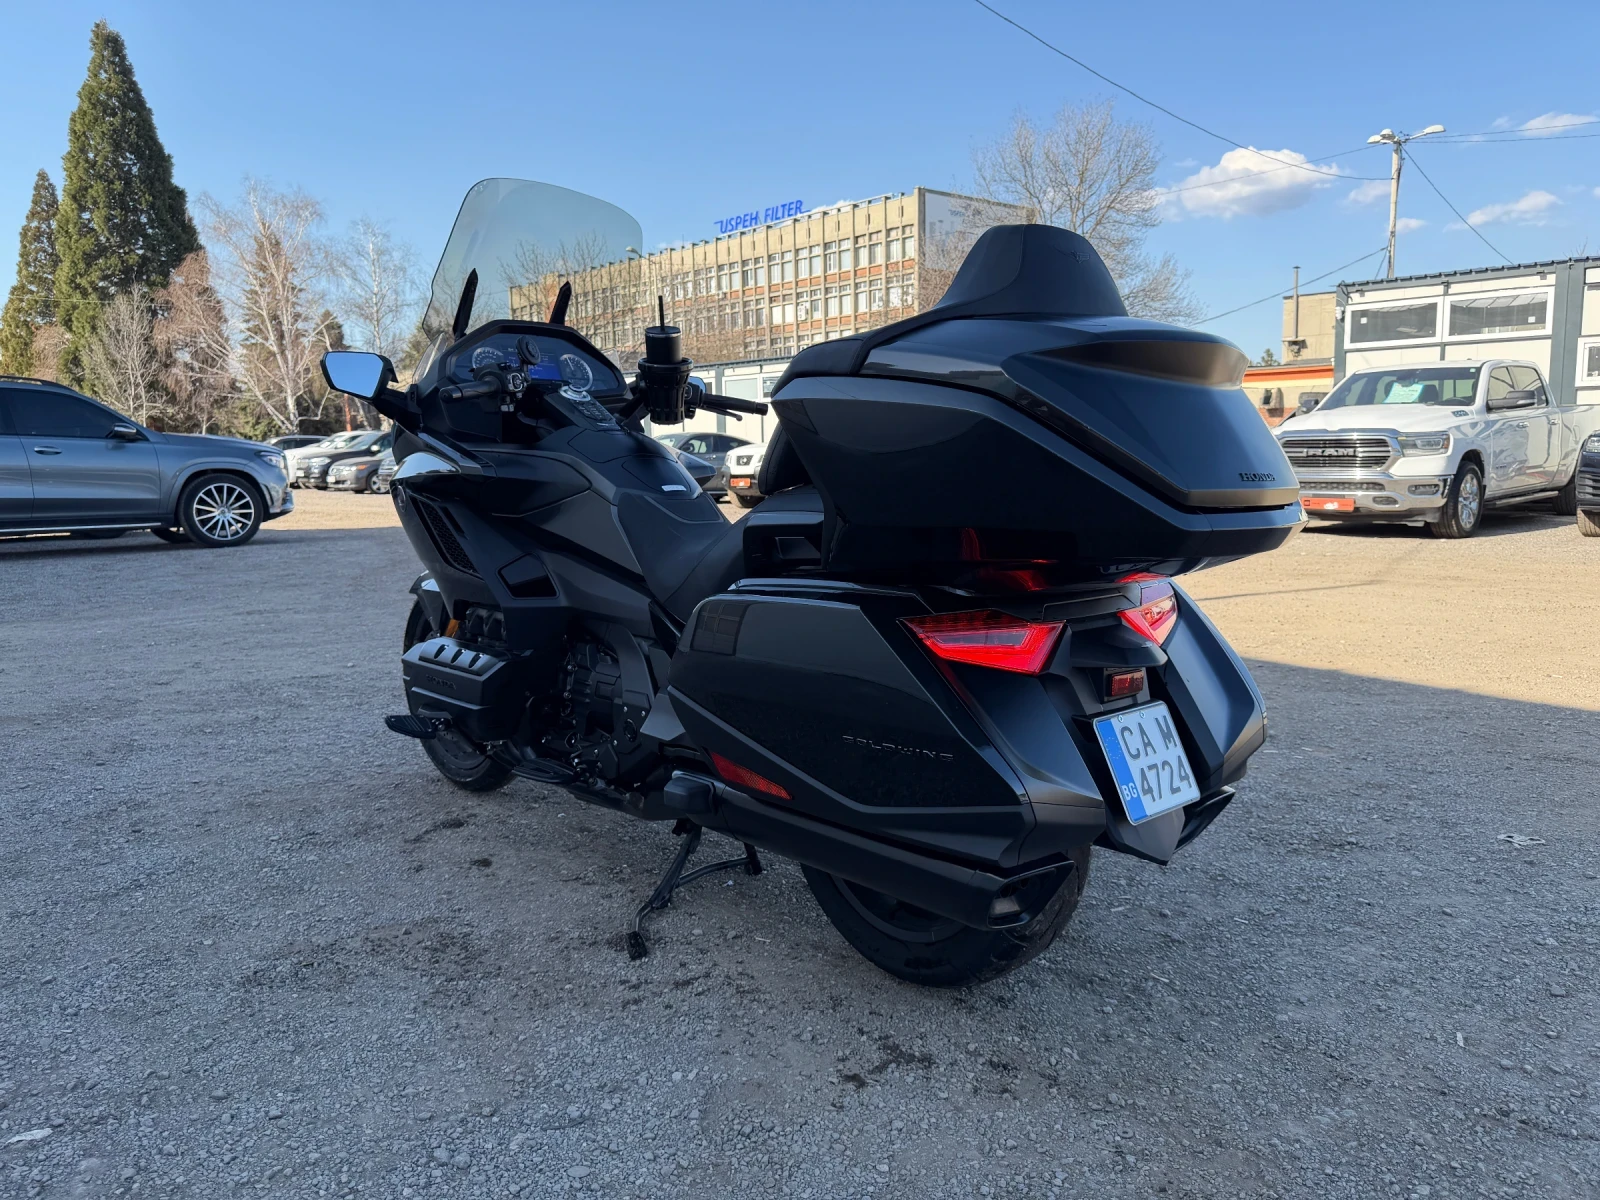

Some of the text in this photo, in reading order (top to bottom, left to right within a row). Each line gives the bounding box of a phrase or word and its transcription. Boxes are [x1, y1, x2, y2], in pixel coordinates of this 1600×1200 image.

[716, 199, 806, 234] USPEH FILTER
[1119, 714, 1178, 761] CA M
[1121, 782, 1138, 801] BG
[1139, 754, 1193, 803] 4724
